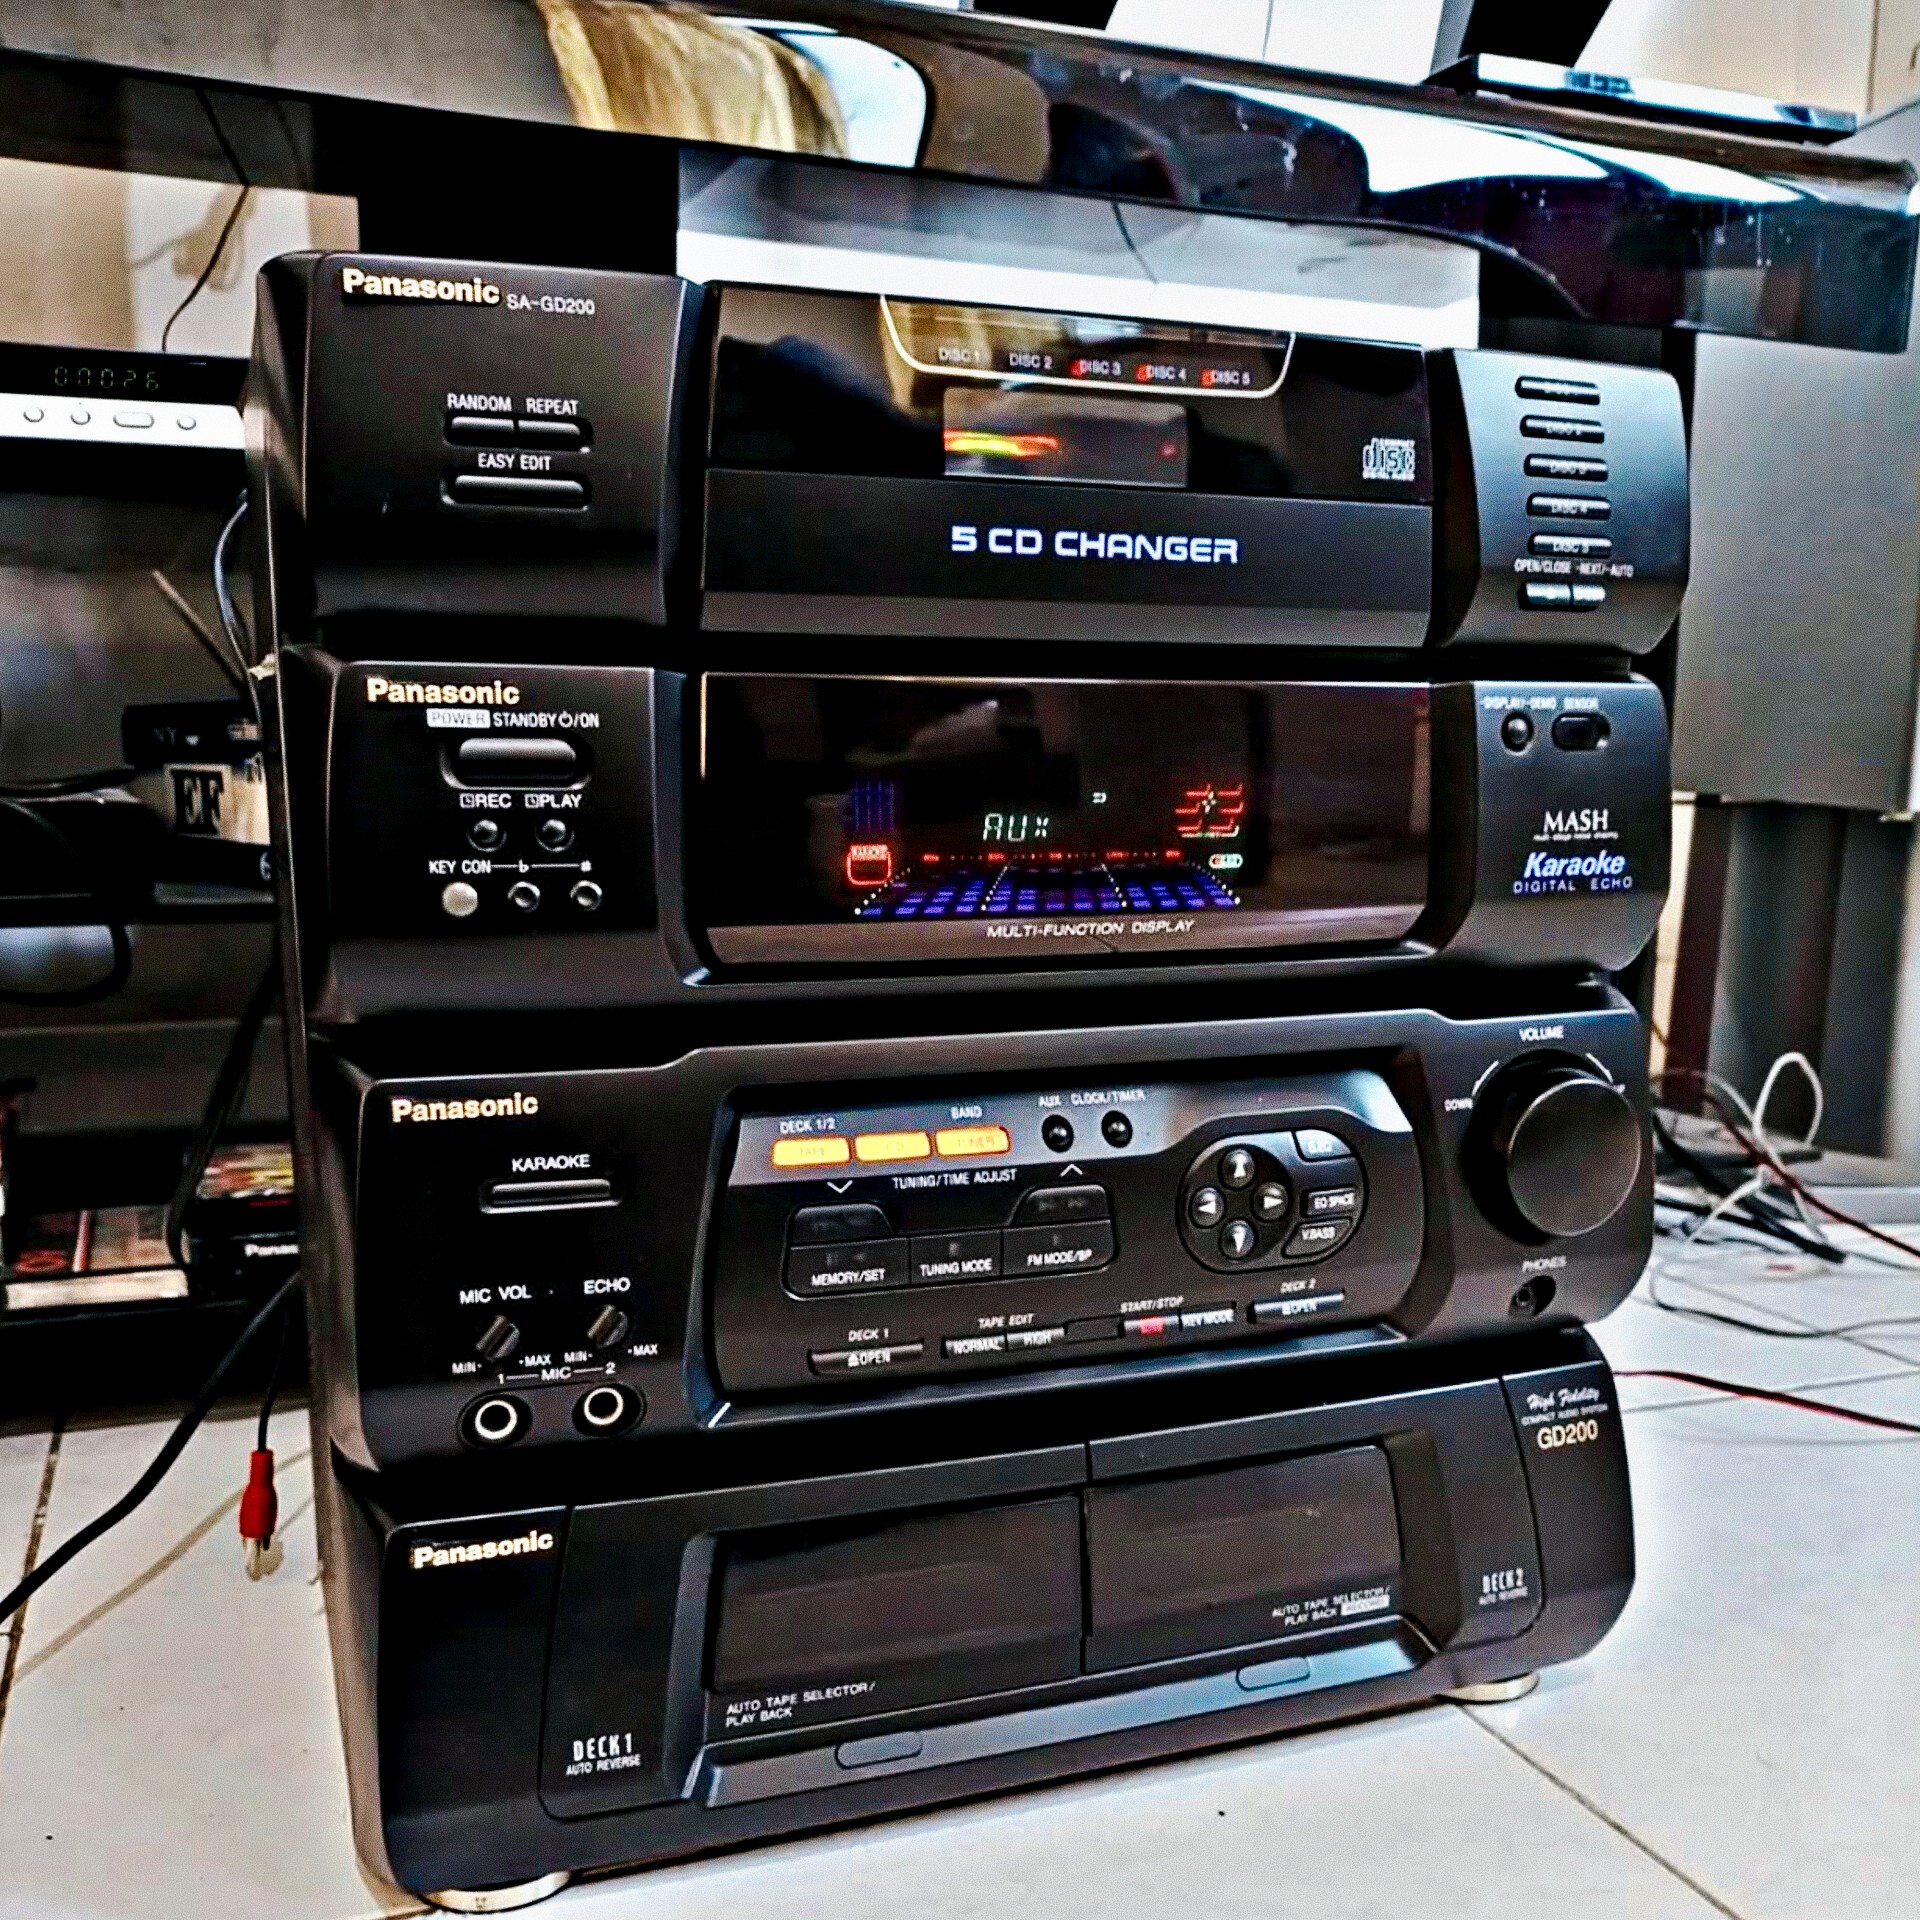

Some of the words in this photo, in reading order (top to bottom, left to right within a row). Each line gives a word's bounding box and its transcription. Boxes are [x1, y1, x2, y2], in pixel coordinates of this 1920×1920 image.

[342, 268, 500, 304] Panasonic
[506, 293, 596, 315] SA-GD200
[938, 347, 969, 362] DISC
[1009, 353, 1041, 368] DISC
[1044, 356, 1053, 370] 2
[54, 366, 158, 391] 00026
[1079, 361, 1110, 376] DISC
[1145, 365, 1175, 380] DISC
[1210, 370, 1240, 385] DISC
[447, 394, 511, 412] RANDOM
[526, 397, 578, 416] REPEAT
[478, 453, 514, 470] EASY
[520, 455, 552, 471] EDIT
[951, 526, 977, 553] 5
[988, 528, 1043, 556] CD
[1054, 531, 1240, 564] CHANGER
[366, 678, 520, 704] Panasonic
[431, 710, 487, 727] POWER
[492, 711, 556, 728] STANDBY
[476, 794, 512, 808] REC
[539, 793, 583, 808] PLAY
[982, 813, 1050, 842] AUX
[1542, 808, 1609, 833] MASH
[429, 860, 457, 874] KEY
[461, 860, 491, 874] CON
[1523, 849, 1626, 879] Karaoke
[1512, 879, 1576, 895] DIGITAL
[1590, 875, 1633, 891] ECHO
[986, 921, 1124, 939] MULTI-FUNCTION
[1131, 919, 1195, 936] DISPLAY
[1519, 1025, 1564, 1042] VOLUME
[392, 1092, 539, 1123] Panasonic
[1444, 1098, 1473, 1111] DOWN
[780, 1119, 812, 1134] DECK
[511, 1153, 591, 1172] KARAOKE
[893, 1172, 969, 1190] TUNING/TIME
[974, 1169, 1018, 1184] ADJUST
[920, 1262, 958, 1278] TUNING
[961, 1258, 993, 1274] MODE
[1521, 1256, 1567, 1273] PHONES
[584, 1277, 631, 1295] ECHO
[812, 1268, 886, 1287] MEMORY/SET
[460, 1289, 491, 1305] MIC
[498, 1285, 532, 1301] VOL
[1120, 1295, 1184, 1313] START/STOP
[978, 1316, 1005, 1329] TAPE
[1008, 1313, 1034, 1326] EDIT
[848, 1329, 879, 1342] DECK
[525, 1354, 551, 1367] MAX
[633, 1344, 658, 1357] MAX
[497, 1373, 505, 1385] 1
[541, 1366, 572, 1382] MIC
[605, 1362, 616, 1375] 2
[1537, 1419, 1599, 1450] GD200
[413, 1530, 554, 1569] Panasonic
[726, 1701, 761, 1716] AUTO
[766, 1693, 797, 1708] TAPE
[726, 1713, 756, 1728] PLAY
[761, 1706, 793, 1722] BACK
[572, 1732, 622, 1761] DECK
[625, 1732, 633, 1754] 1
[566, 1762, 593, 1777] AUTO
[596, 1754, 641, 1772] REVERSE
